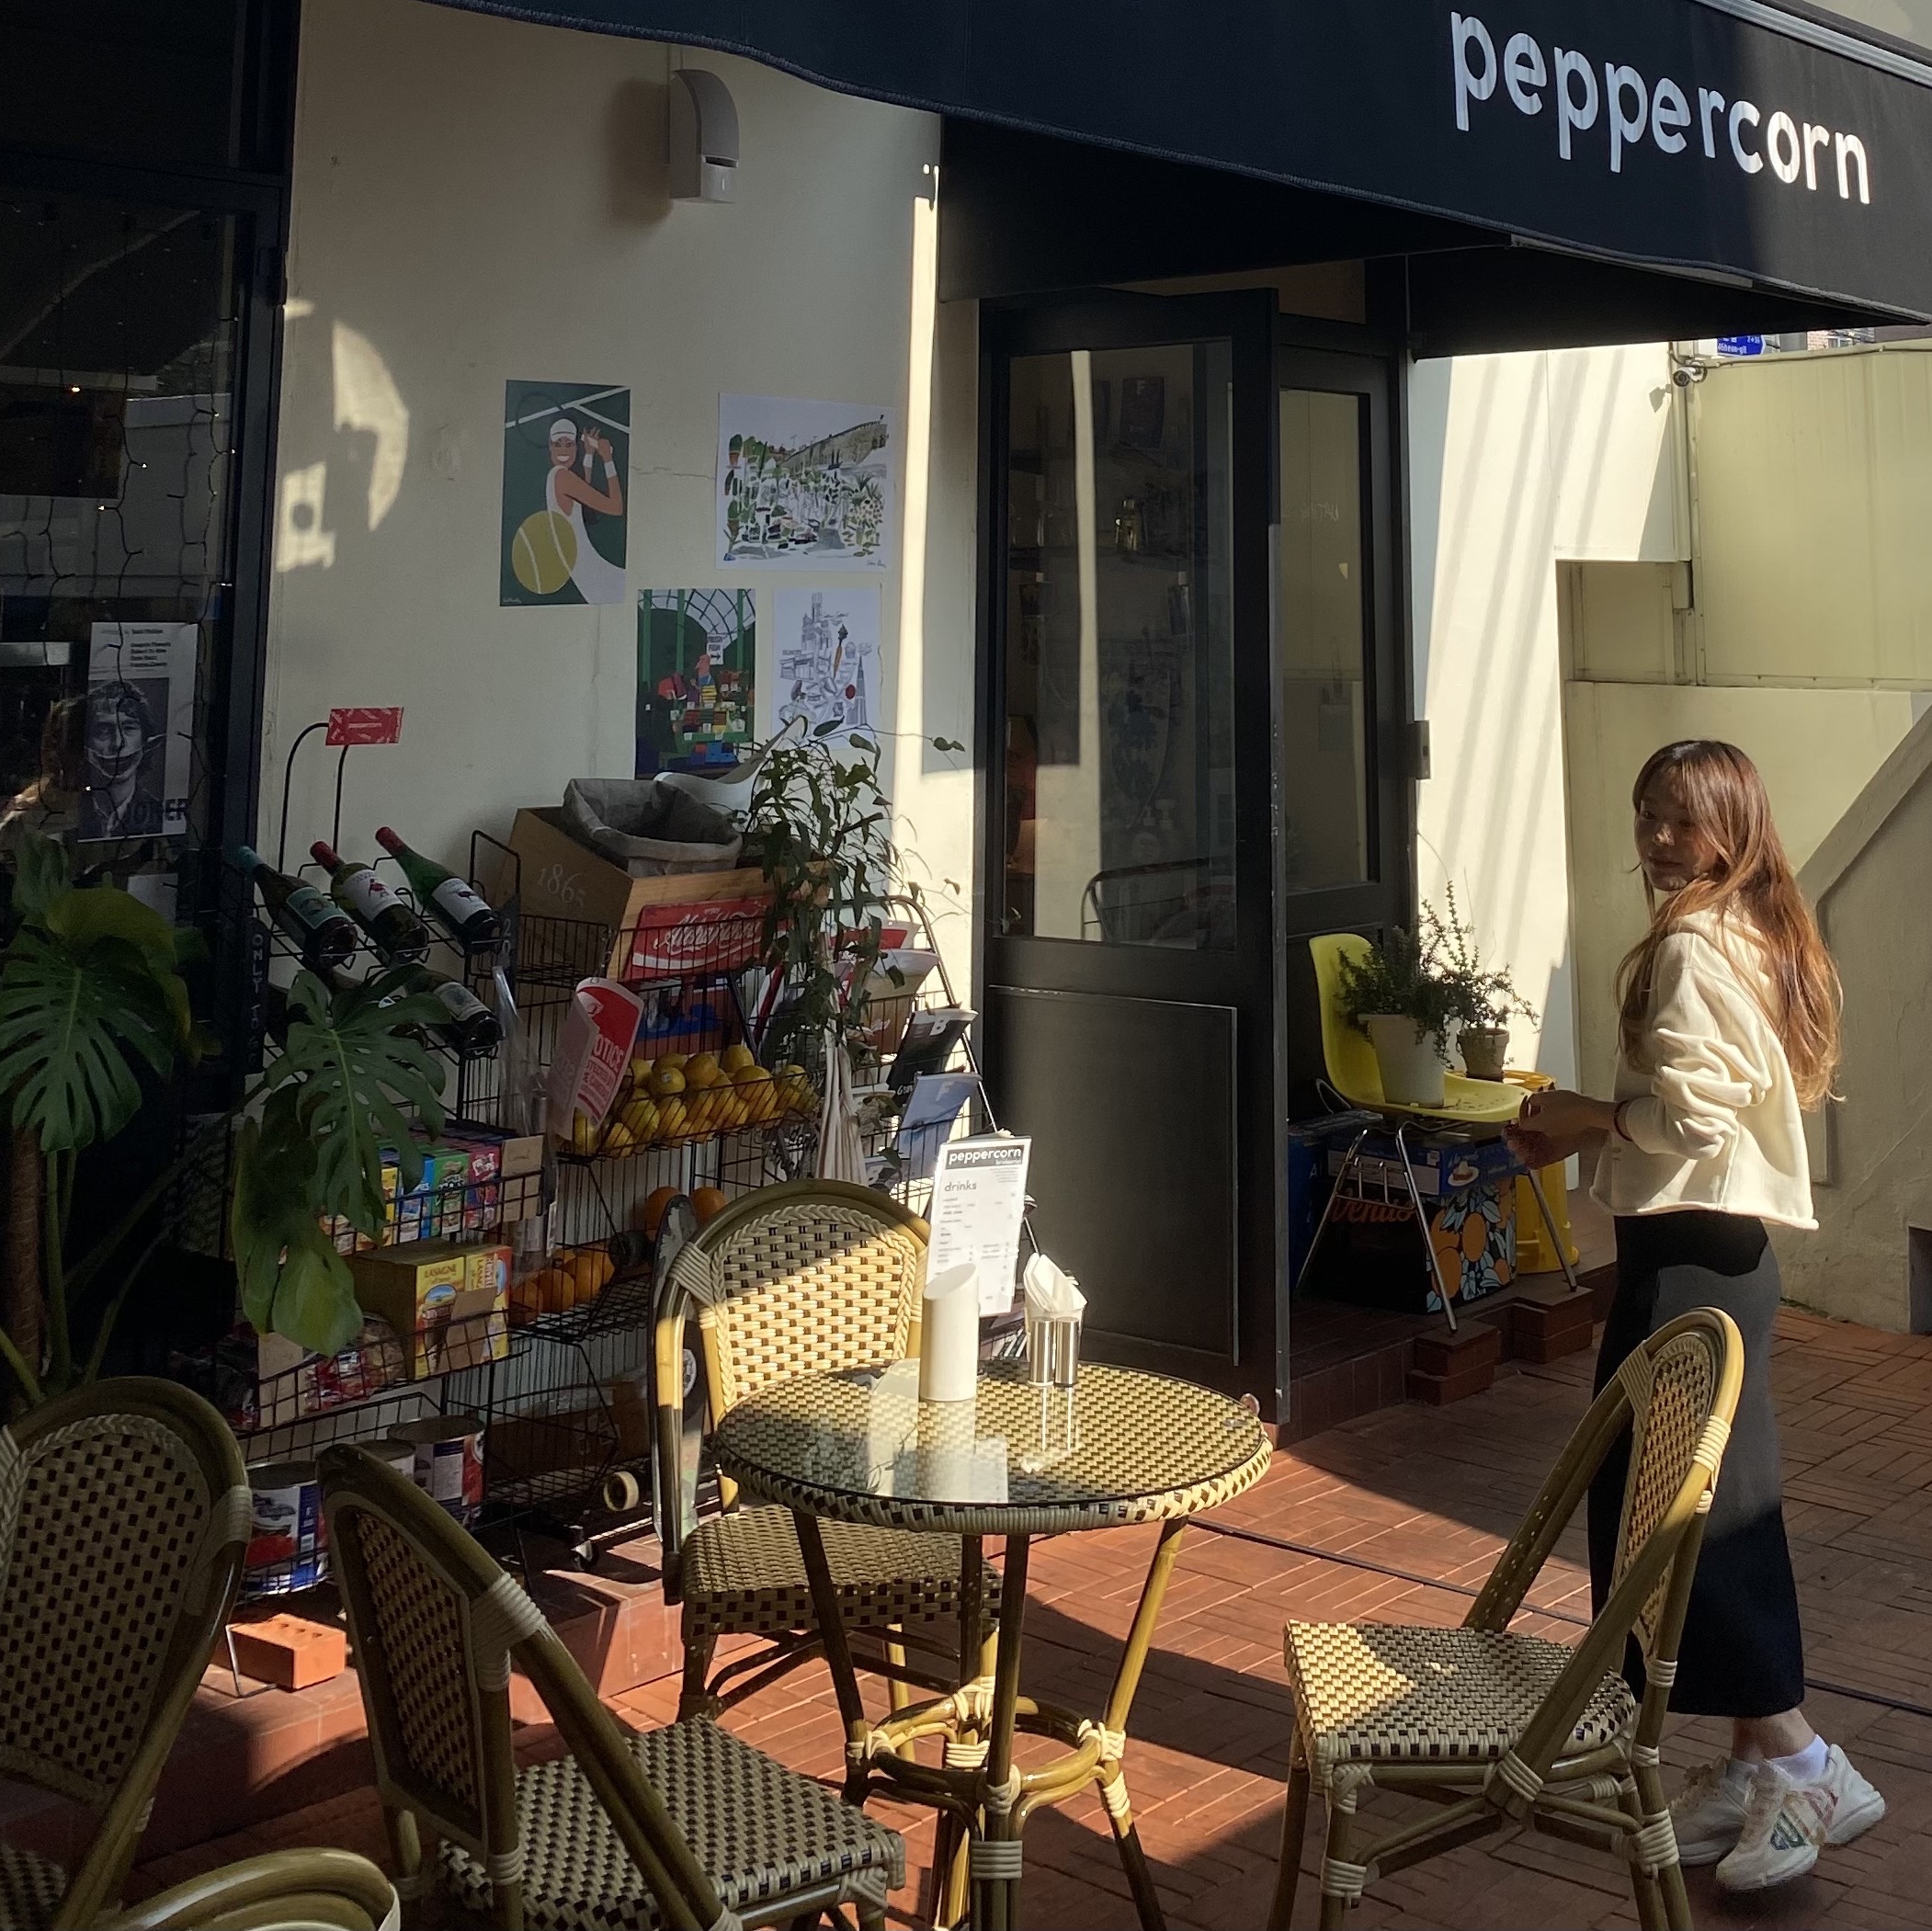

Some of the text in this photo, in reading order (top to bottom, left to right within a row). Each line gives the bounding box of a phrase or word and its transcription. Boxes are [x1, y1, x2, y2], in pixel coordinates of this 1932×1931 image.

[1450, 11, 1871, 204] peppercorn
[929, 1014, 950, 1037] B
[949, 1147, 1022, 1165] peppercorn
[944, 1179, 978, 1192] drinks
